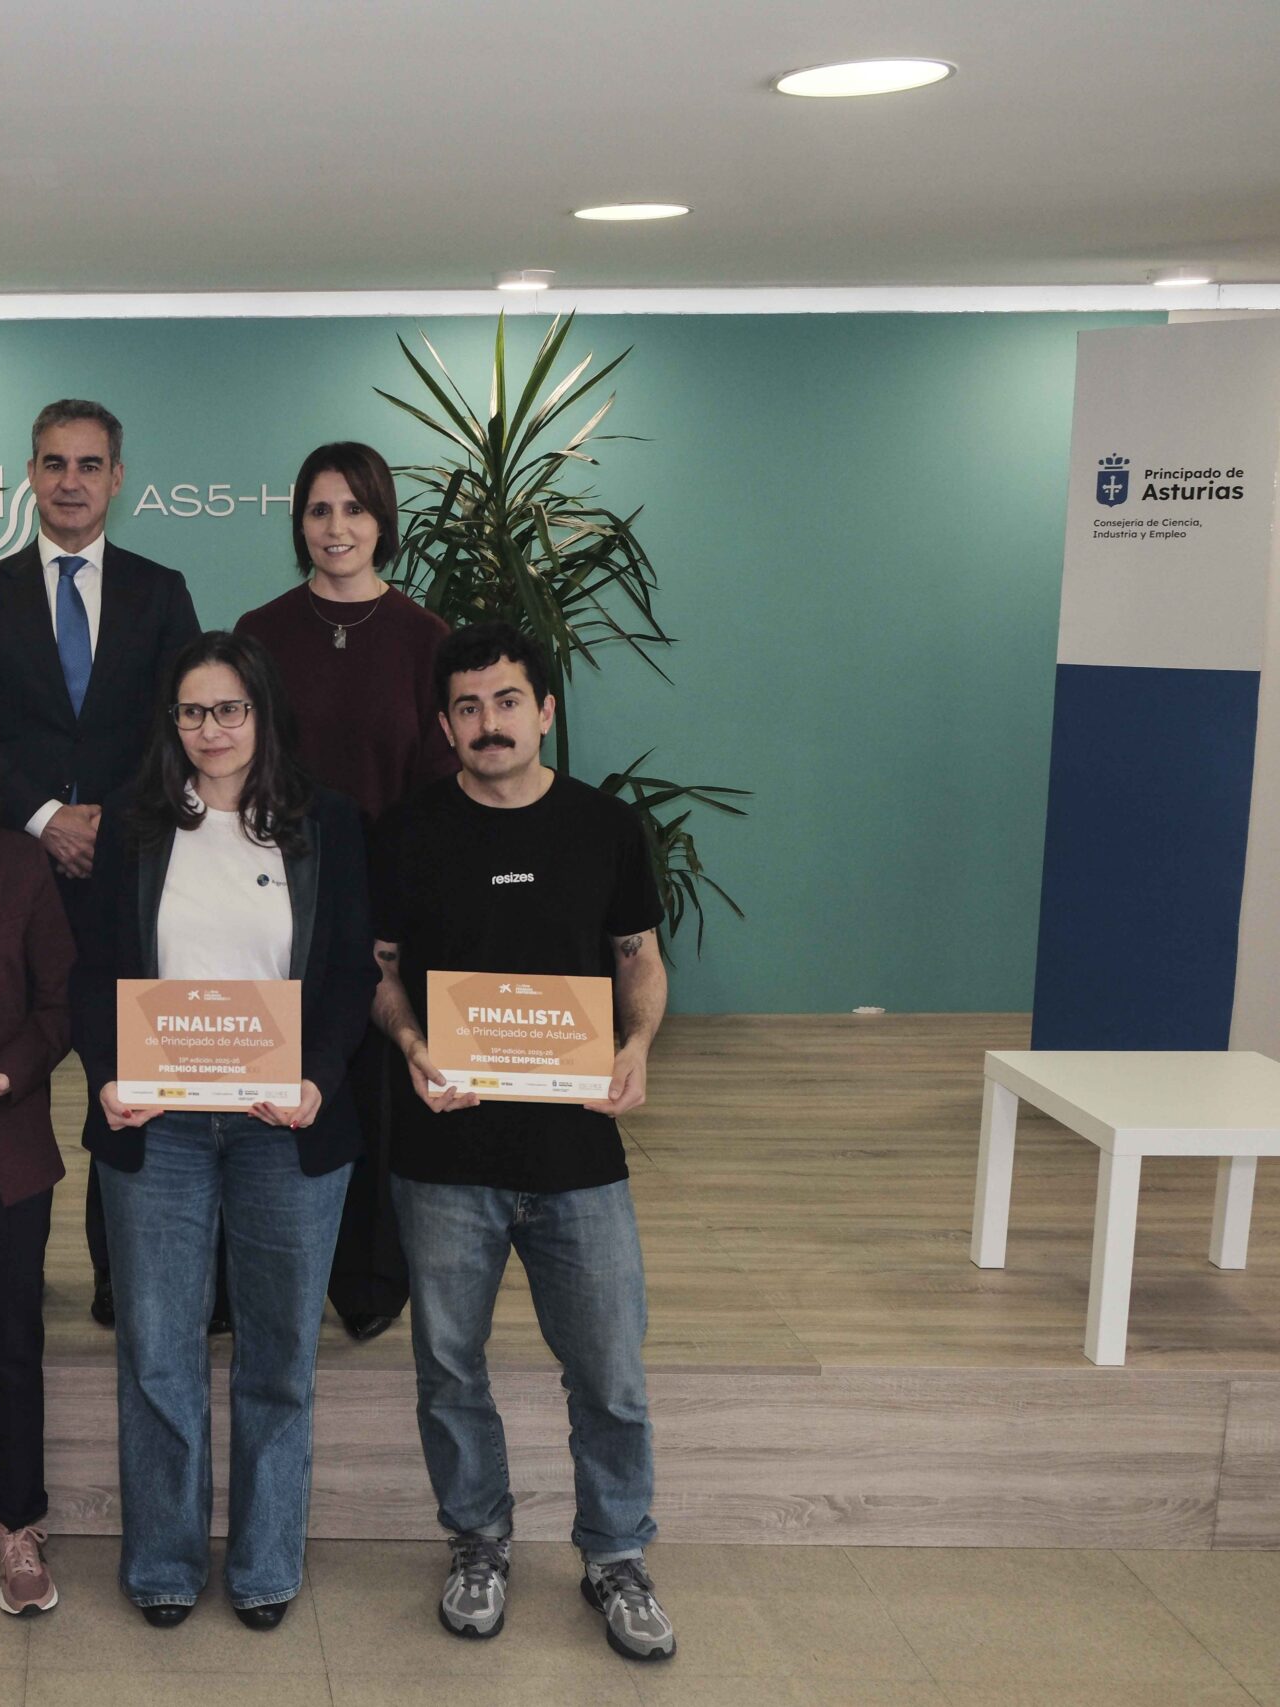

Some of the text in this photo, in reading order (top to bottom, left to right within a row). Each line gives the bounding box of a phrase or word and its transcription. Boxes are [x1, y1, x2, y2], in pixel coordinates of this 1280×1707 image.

[1145, 467, 1244, 482] Principado de
[1142, 480, 1244, 501] Asturias
[1146, 519, 1159, 527] de
[1162, 518, 1203, 528] Ciencia,
[1093, 530, 1187, 540] Industria y Empleo
[492, 872, 534, 885] resizes
[468, 1007, 575, 1026] FINALISTA
[157, 1016, 262, 1033] FINALISTA
[456, 1026, 588, 1041] de Principado de Asturias
[145, 1036, 274, 1048] de Principado de Asturias
[470, 1055, 510, 1064] PREMIOS
[159, 1065, 197, 1073] PREMIOS
